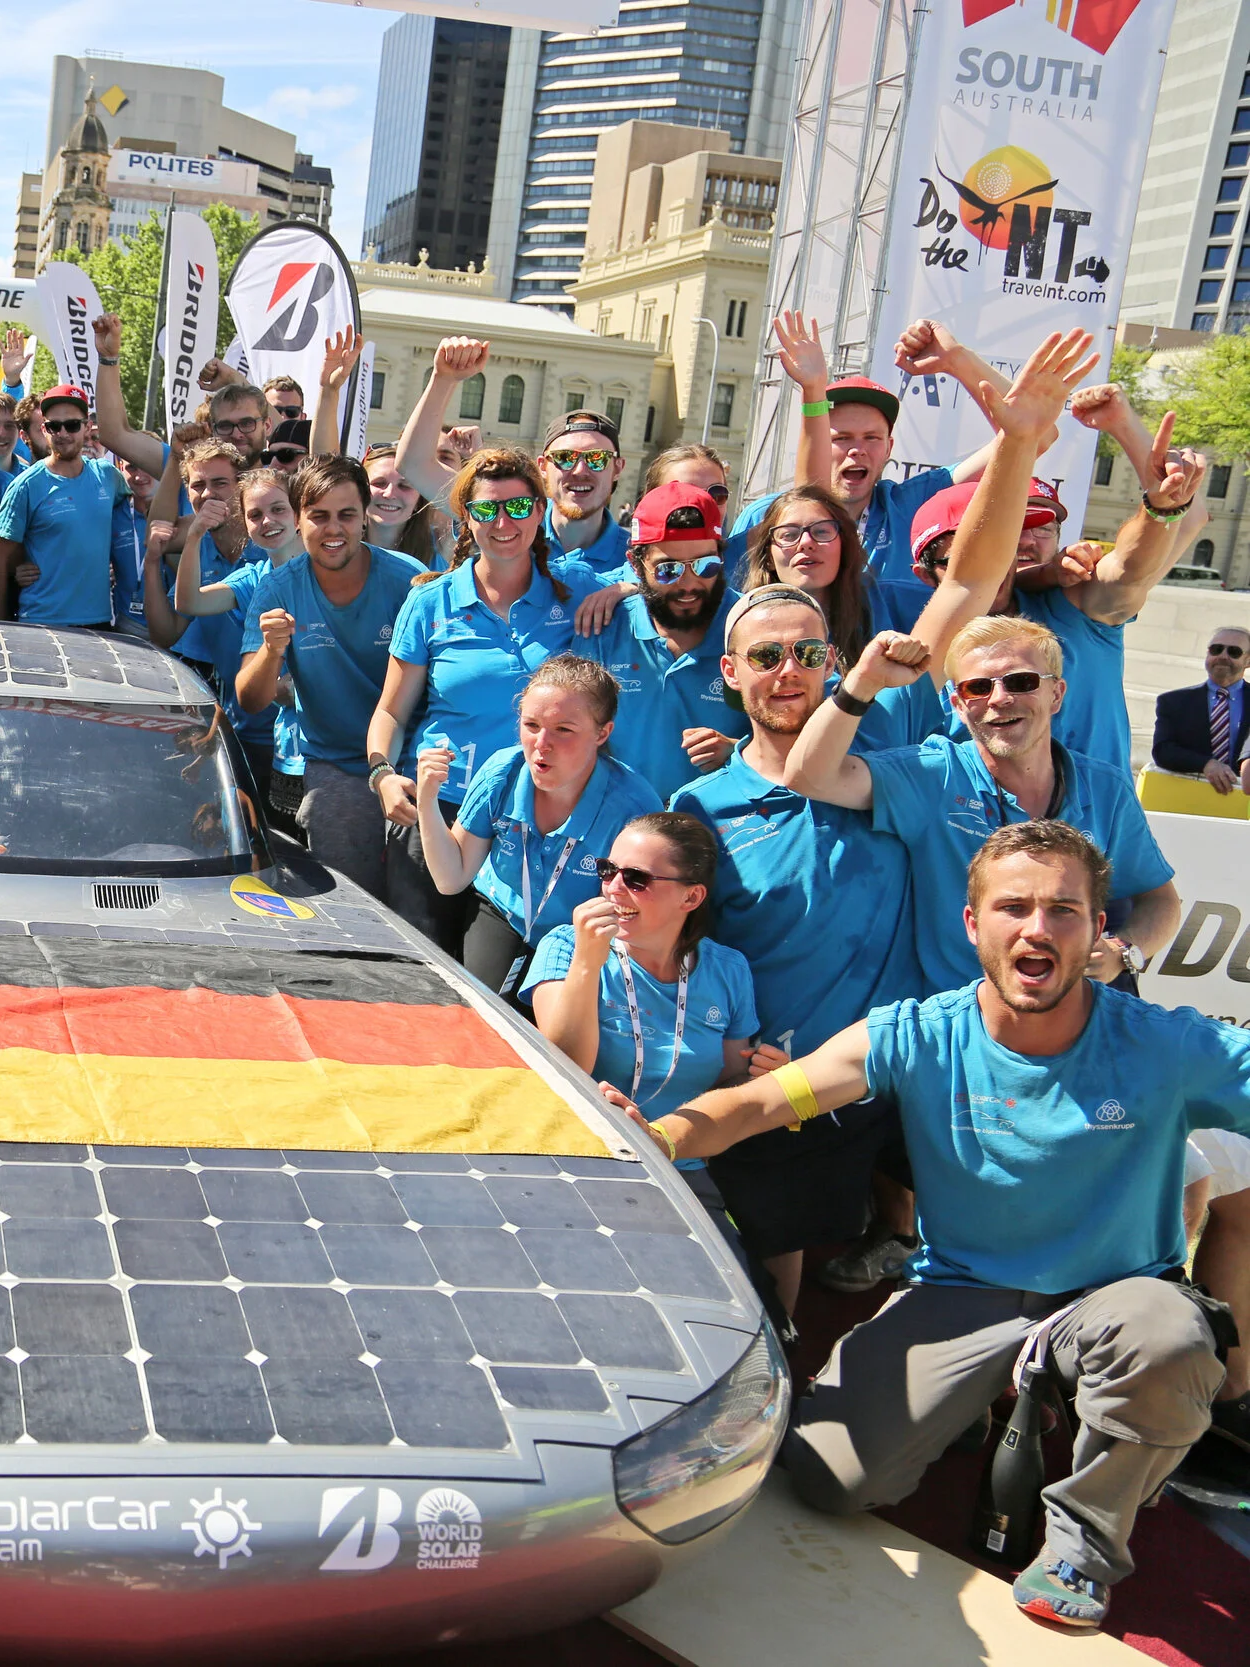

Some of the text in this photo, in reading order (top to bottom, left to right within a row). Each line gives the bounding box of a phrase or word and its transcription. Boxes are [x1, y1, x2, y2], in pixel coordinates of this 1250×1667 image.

[955, 47, 1103, 101] SOUTH
[953, 88, 1094, 123] AUSTRALIA
[128, 153, 215, 177] POLITES
[912, 177, 958, 234] Do
[921, 203, 1093, 284] the NT
[1001, 277, 1107, 304] travelnt.com
[1083, 1121, 1136, 1133] thyssenkrupp
[418, 1523, 484, 1541] WORLD
[417, 1541, 483, 1559] SOLAR
[416, 1558, 480, 1571] CHALLENGE
